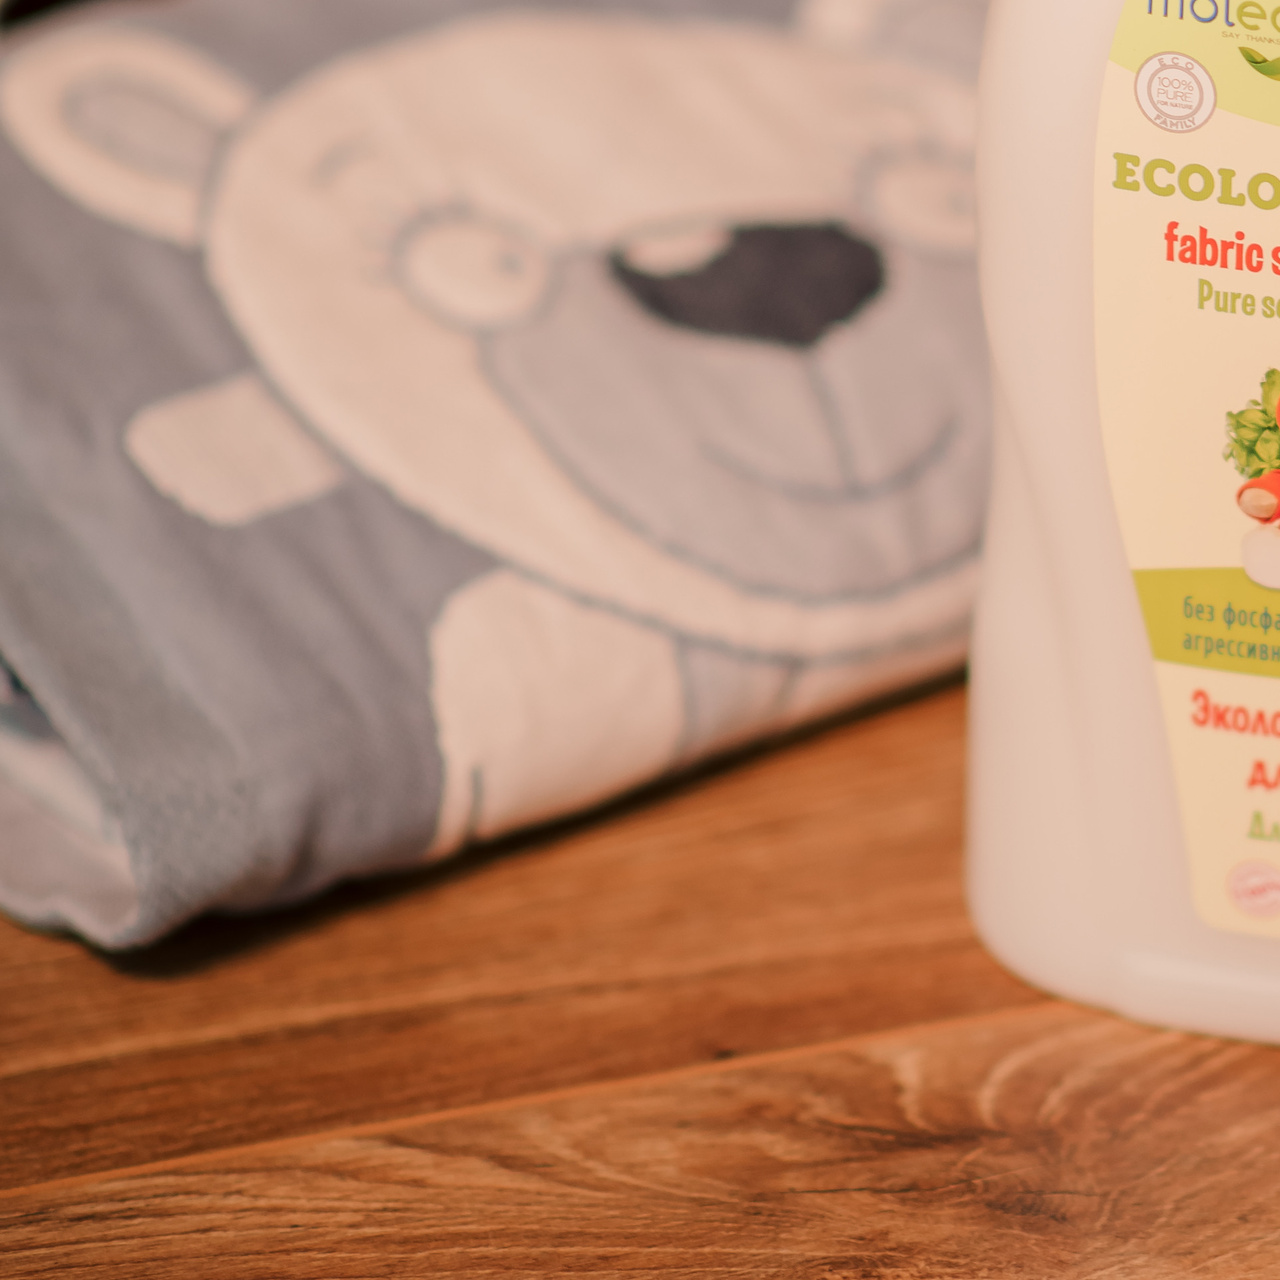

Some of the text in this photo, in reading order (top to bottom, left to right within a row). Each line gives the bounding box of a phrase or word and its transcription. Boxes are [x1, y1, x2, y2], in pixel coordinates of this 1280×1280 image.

[1221, 31, 1240, 39] SAY
[1157, 56, 1195, 71] ECO
[1157, 76, 1194, 92] 100%
[1157, 87, 1193, 102] PURE
[1154, 113, 1196, 129] FAMILY
[1164, 221, 1264, 273] fabric
[1197, 277, 1256, 316] Pure
[1183, 596, 1215, 622] без
